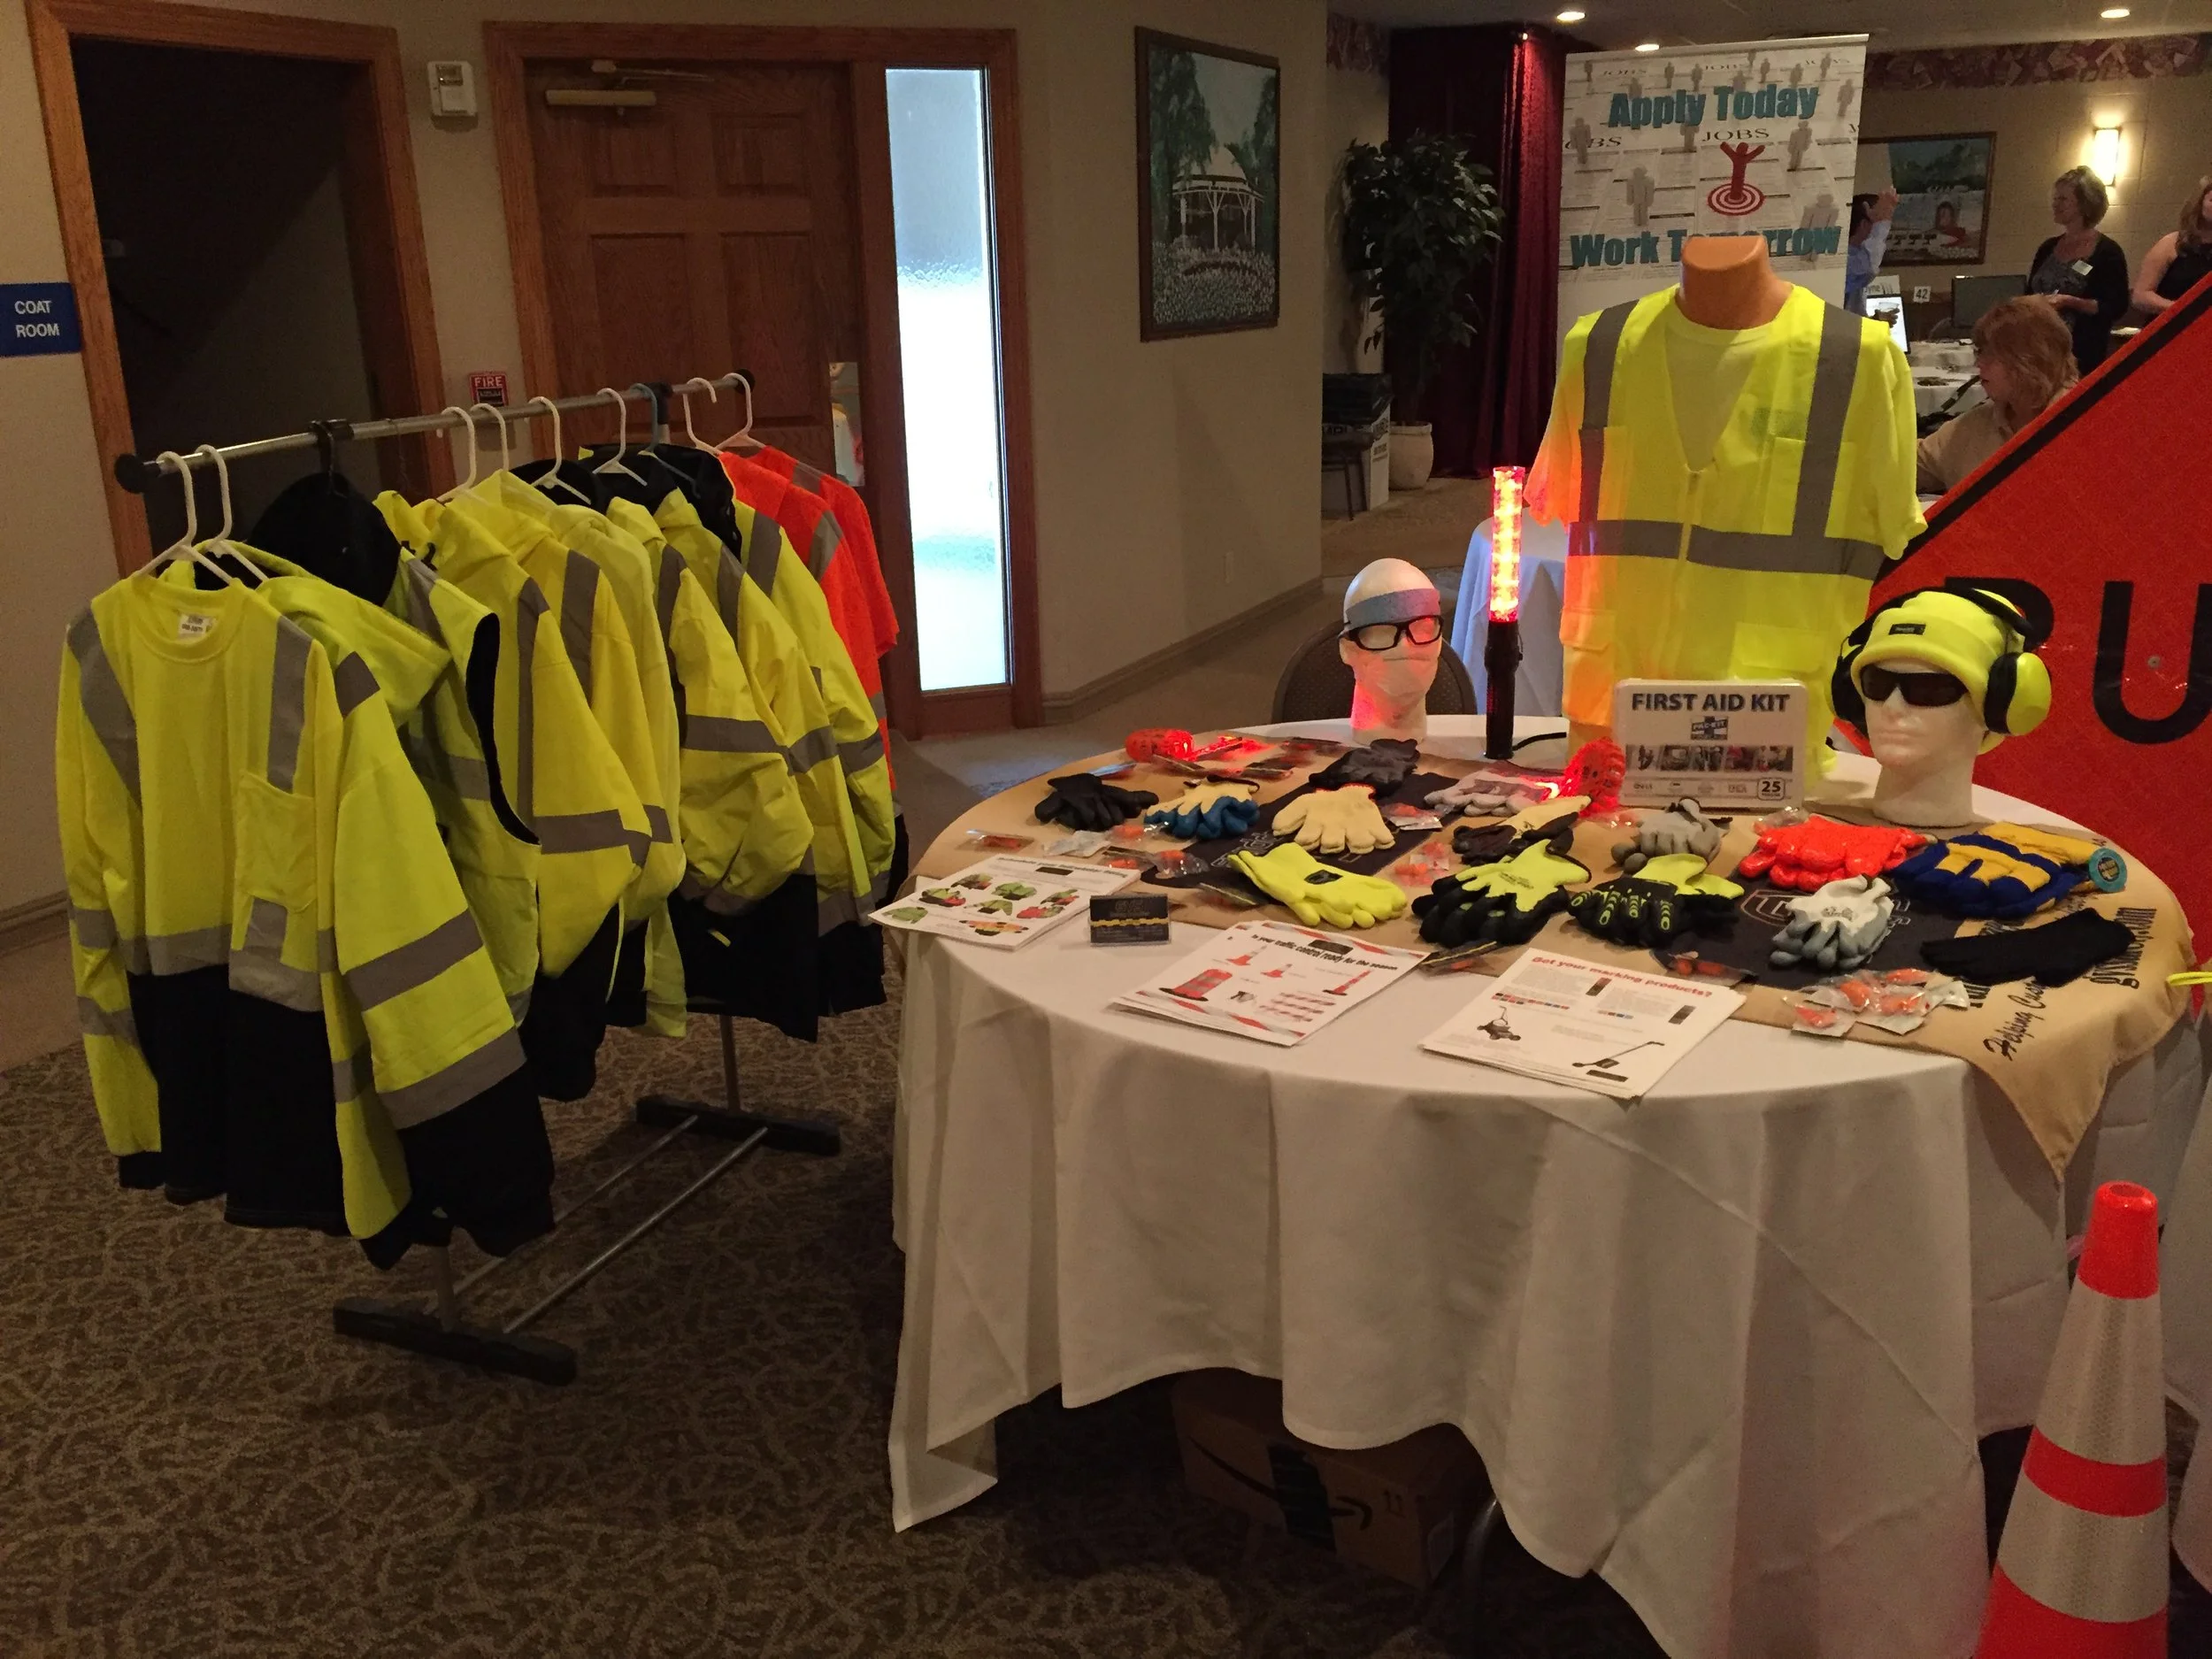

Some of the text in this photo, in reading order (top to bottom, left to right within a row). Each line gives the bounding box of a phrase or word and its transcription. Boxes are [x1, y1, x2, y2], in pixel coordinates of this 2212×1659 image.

[1608, 84, 1819, 129] Apply Today
[1701, 127, 1770, 142] JOBS
[1570, 226, 1842, 267] Work Trrow
[1916, 288, 1929, 299] 42
[14, 300, 52, 315] COAT
[15, 323, 60, 338] ROOM
[474, 376, 503, 388] FIRE
[1632, 693, 1791, 712] FIRST AID KIT
[1762, 780, 1781, 793] 25
[1274, 940, 1297, 949] traffic
[1294, 946, 1322, 958] control
[1320, 950, 1343, 964] ready
[1556, 961, 1586, 971] your
[1589, 967, 1643, 983] marking
[1644, 979, 1713, 998] products?
